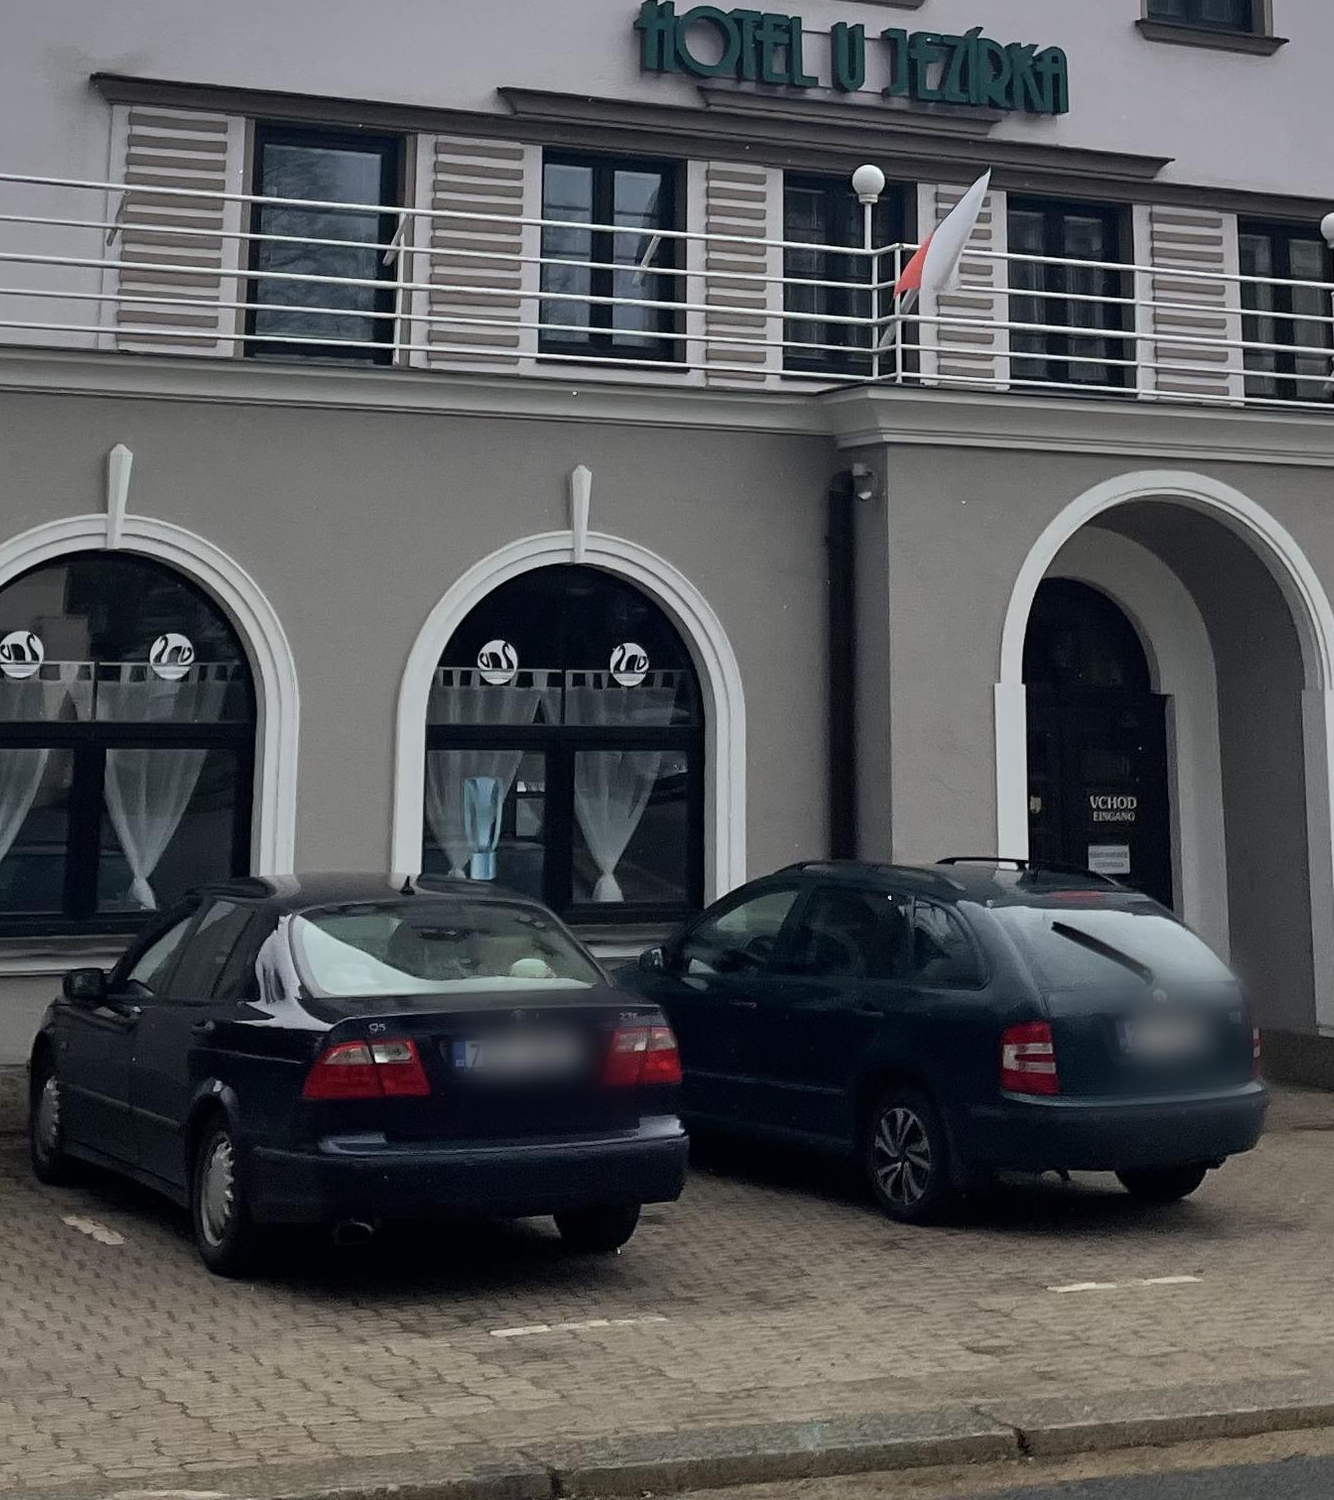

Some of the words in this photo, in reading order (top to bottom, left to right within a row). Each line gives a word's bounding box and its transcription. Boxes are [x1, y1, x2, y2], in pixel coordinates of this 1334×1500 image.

[634, 0, 818, 88] HOTEL
[830, 21, 865, 92] U
[880, 26, 1070, 115] JEZÍRKA
[1089, 795, 1137, 809] VCHOD
